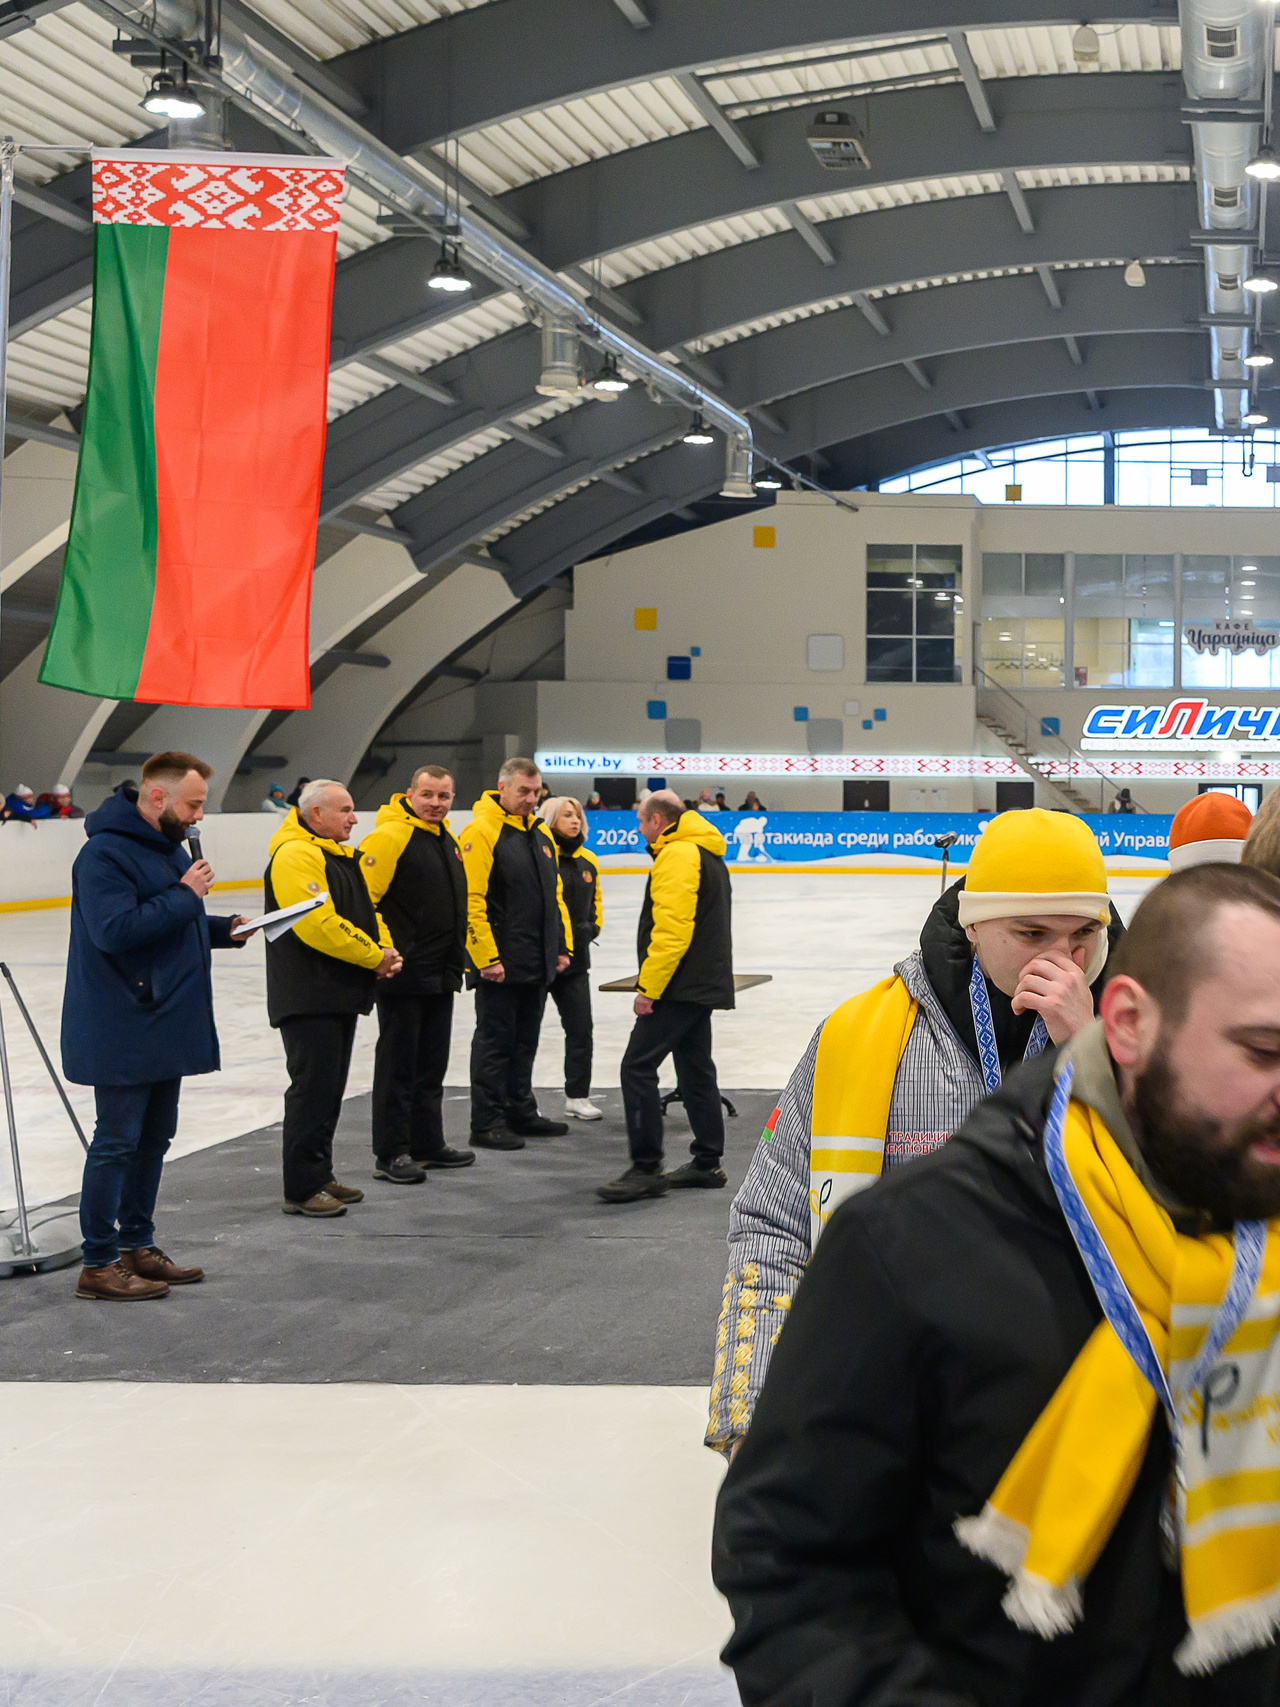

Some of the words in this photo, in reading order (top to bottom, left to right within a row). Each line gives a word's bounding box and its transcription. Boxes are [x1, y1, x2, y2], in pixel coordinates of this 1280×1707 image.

[1215, 622, 1250, 631] КАФЕ
[544, 756, 622, 770] silichy.by
[596, 829, 639, 846] 2026
[837, 831, 889, 848] среди
